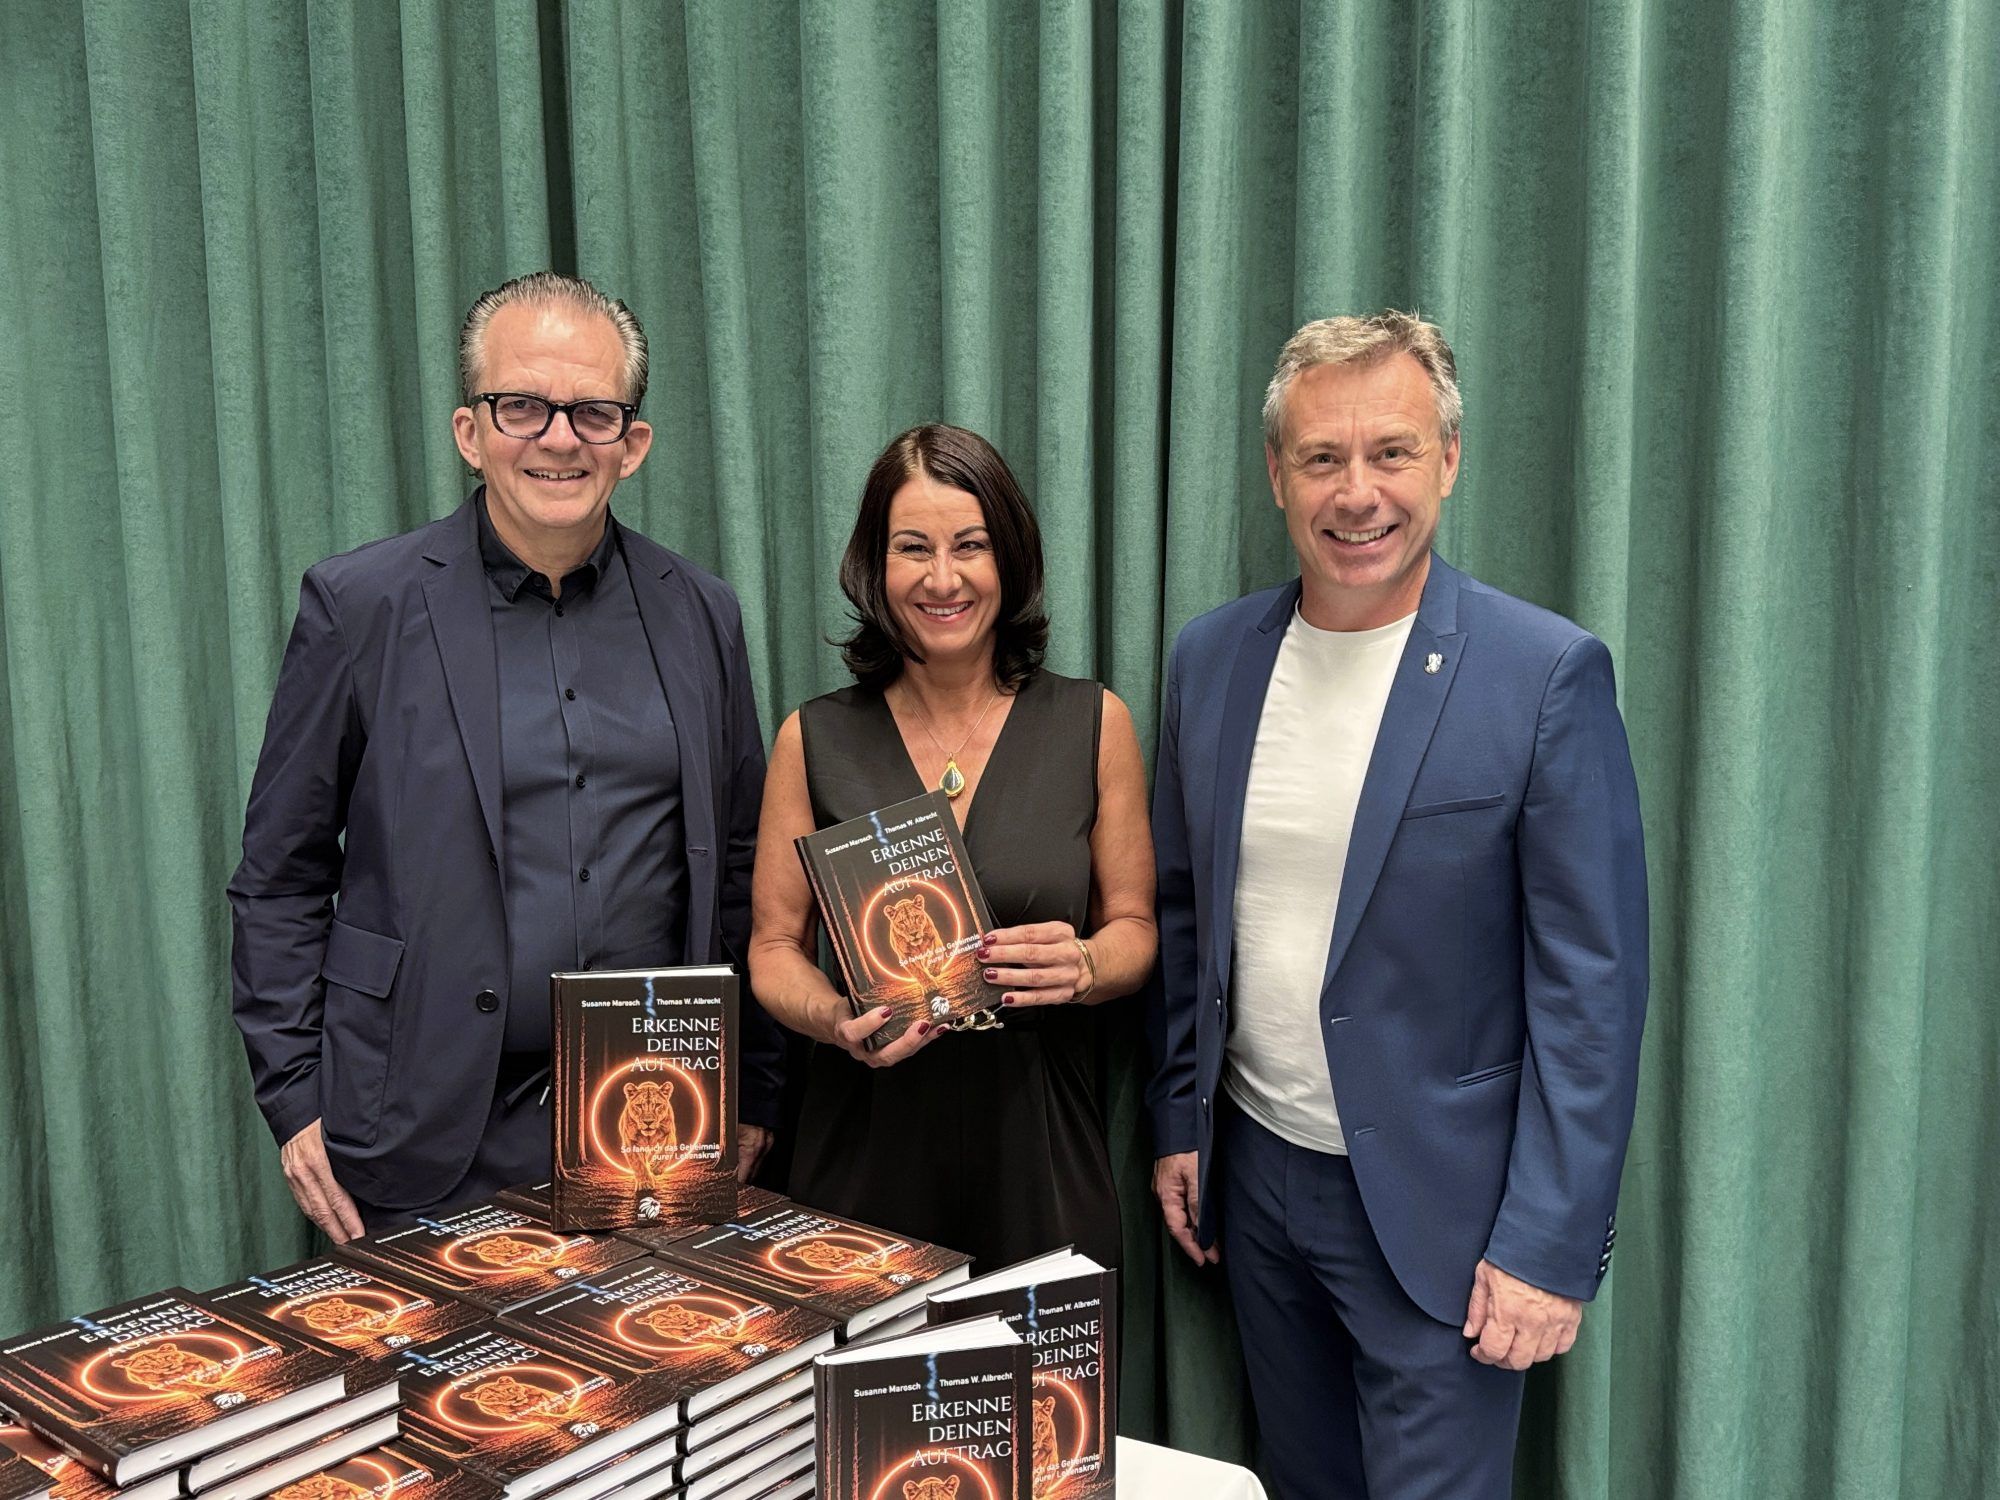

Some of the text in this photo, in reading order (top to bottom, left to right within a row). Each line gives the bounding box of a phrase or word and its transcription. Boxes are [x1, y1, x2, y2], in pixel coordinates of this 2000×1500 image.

[884, 824, 907, 834] Thomas
[915, 811, 938, 824] Albrecht
[825, 834, 873, 855] Susanne Marosch
[870, 828, 945, 864] ERKENNE
[888, 845, 950, 875] DEINEN
[883, 861, 955, 896] AUFTRAG
[581, 999, 641, 1008] Susanne Marosch
[657, 998, 682, 1006] Thomas
[693, 997, 721, 1005] Albrecht
[632, 1017, 721, 1033] ERKENNE
[647, 1037, 720, 1052] DEINEN
[631, 1056, 720, 1072] AUFTRAG
[675, 1151, 720, 1160] Lebenskraft
[680, 1142, 720, 1151] Geheimnis
[258, 1267, 349, 1298] ERKENNE
[285, 1272, 360, 1298] DEINEN
[593, 1271, 674, 1305] ERKENNE
[620, 1276, 688, 1305] DEINEN
[1038, 1307, 1063, 1316] Thomas
[1074, 1298, 1100, 1309] Albrecht
[79, 1304, 192, 1344] ERKENNE
[107, 1318, 215, 1356] AUFTRAG
[109, 1309, 204, 1344] DEINEN
[418, 1337, 512, 1378] ERKENNE
[448, 1342, 526, 1378] DEINEN
[450, 1349, 539, 1390] AUFTRAG
[853, 1382, 921, 1398] Susanne Marosch
[939, 1372, 1013, 1388] Thomas W. Albrecht
[912, 1396, 1012, 1422] ERKENNE
[929, 1418, 1011, 1443] DEINEN
[911, 1441, 1012, 1467] AUFTRAG
